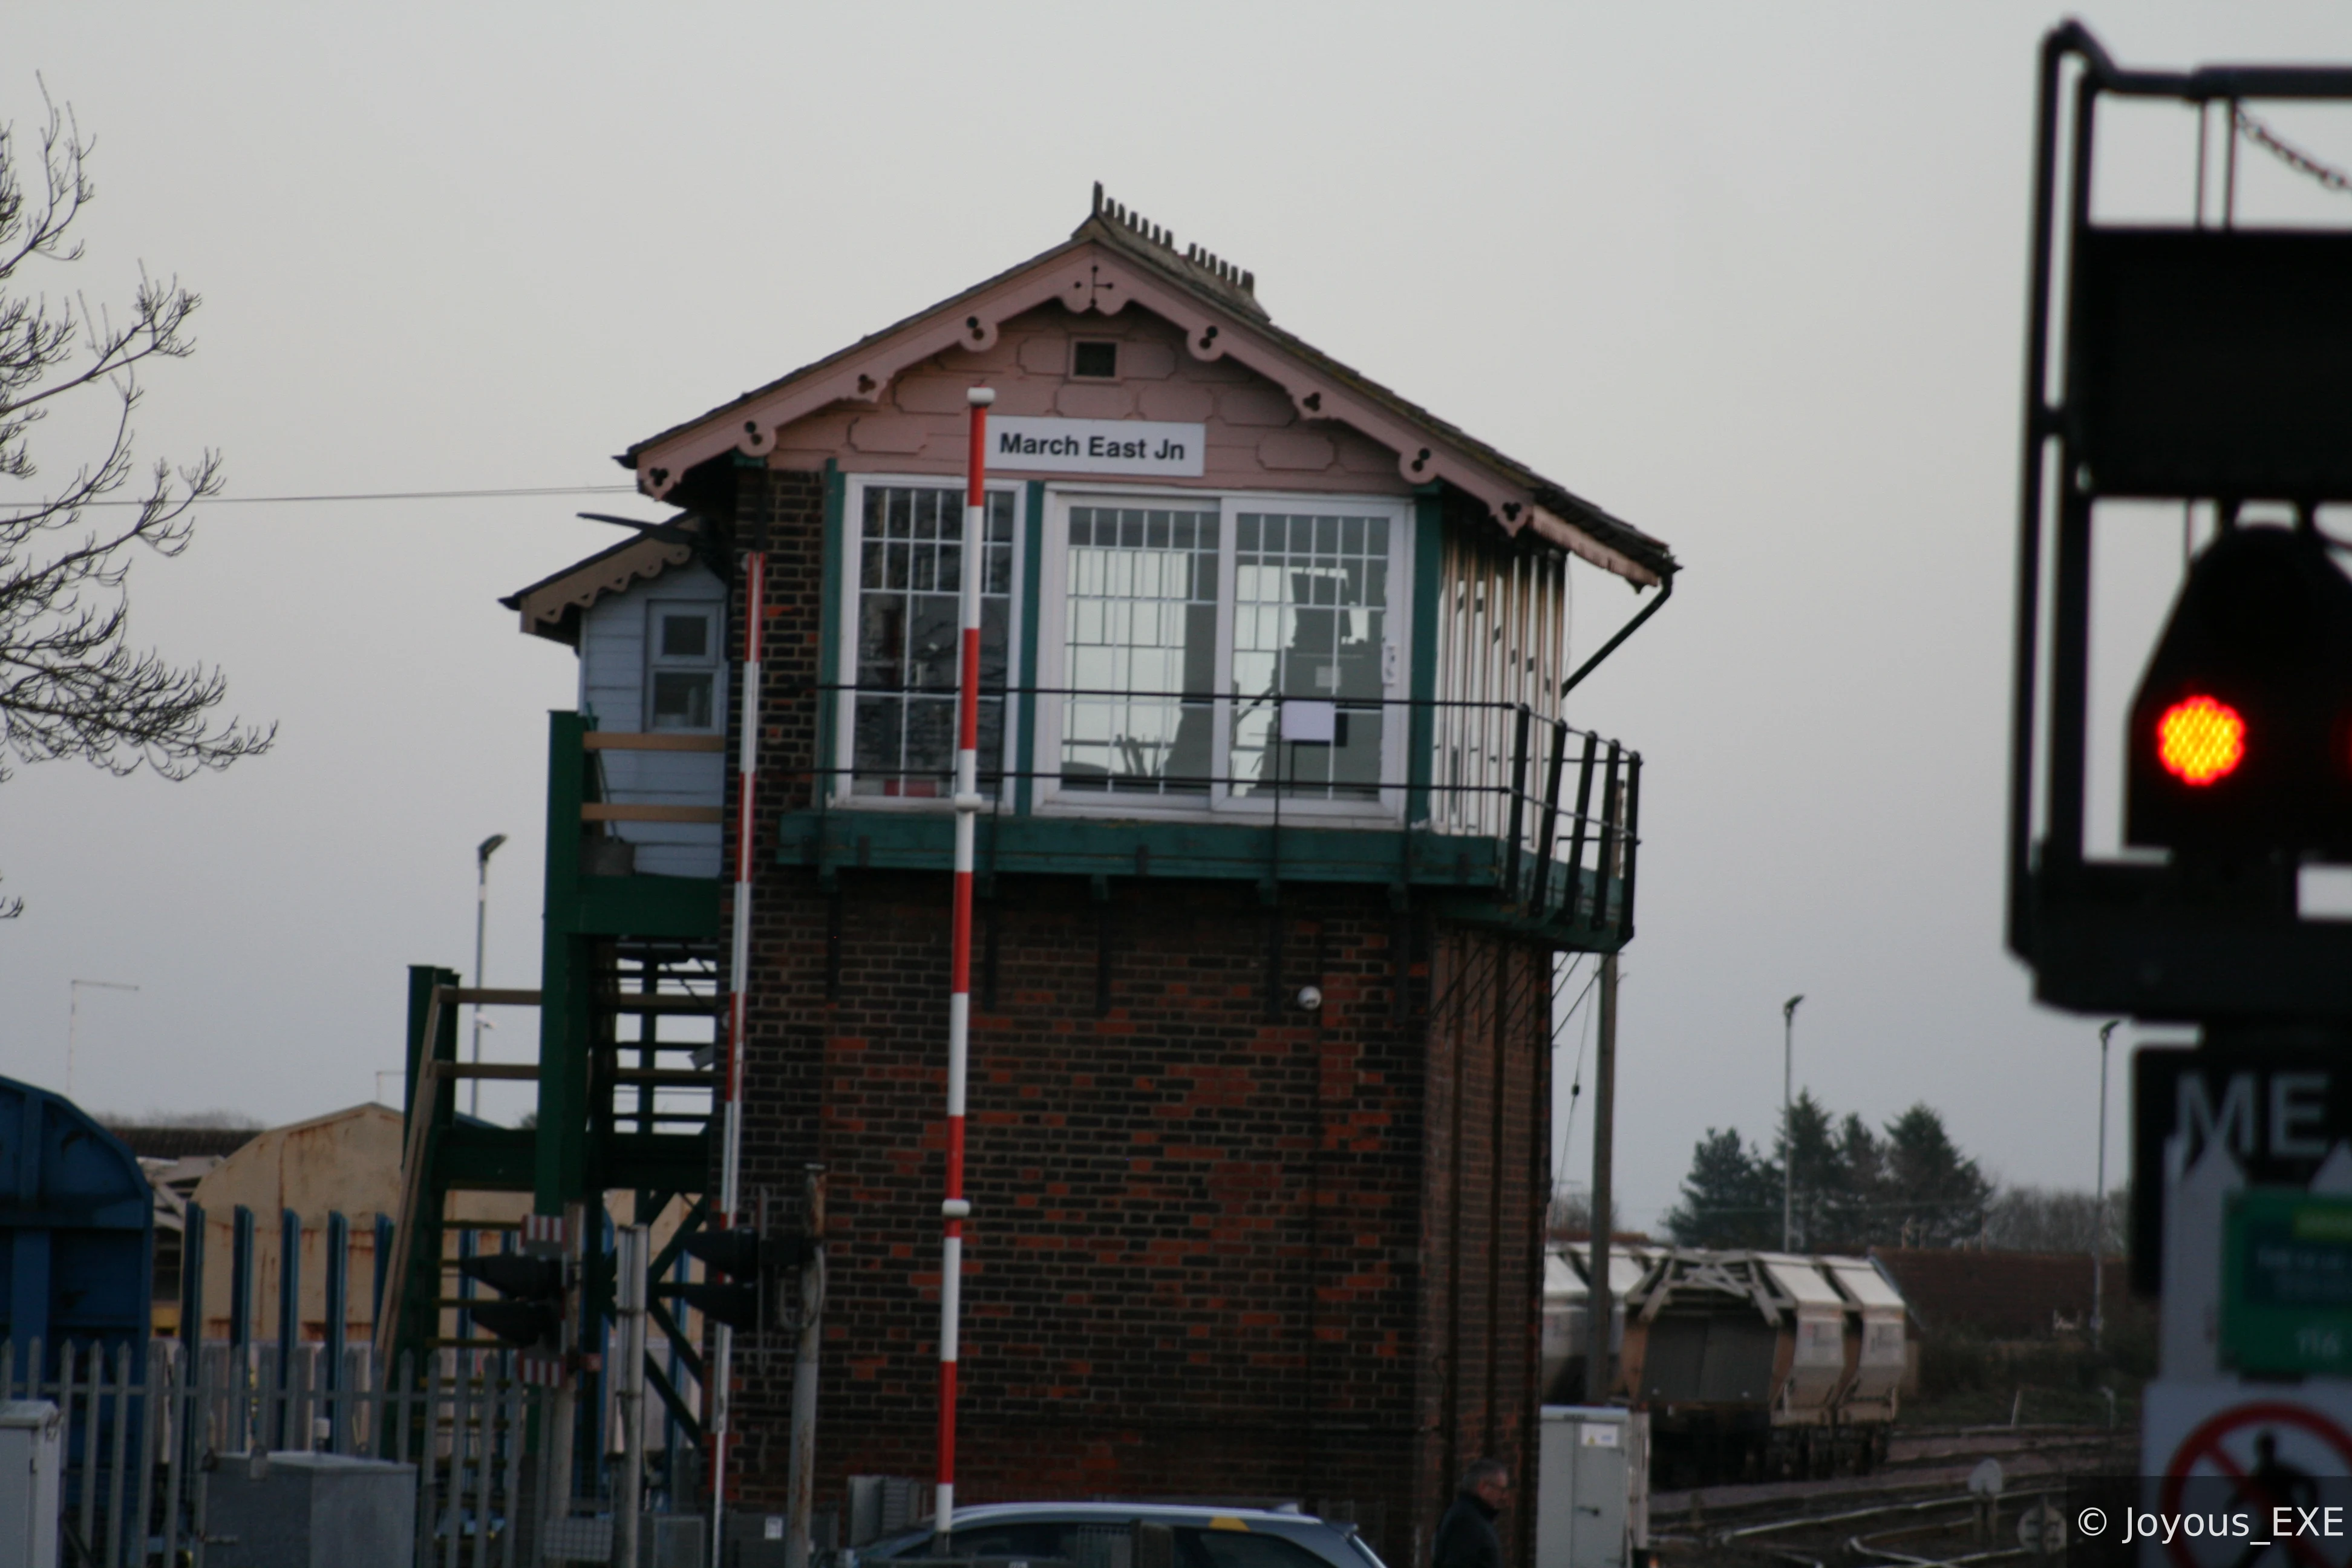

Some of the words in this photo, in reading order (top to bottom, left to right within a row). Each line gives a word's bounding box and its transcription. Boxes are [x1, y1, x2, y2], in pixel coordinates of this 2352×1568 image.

[999, 432, 1079, 456] March
[1088, 436, 1146, 459] East
[1154, 438, 1184, 460] Jn
[2176, 1071, 2331, 1157] ME
